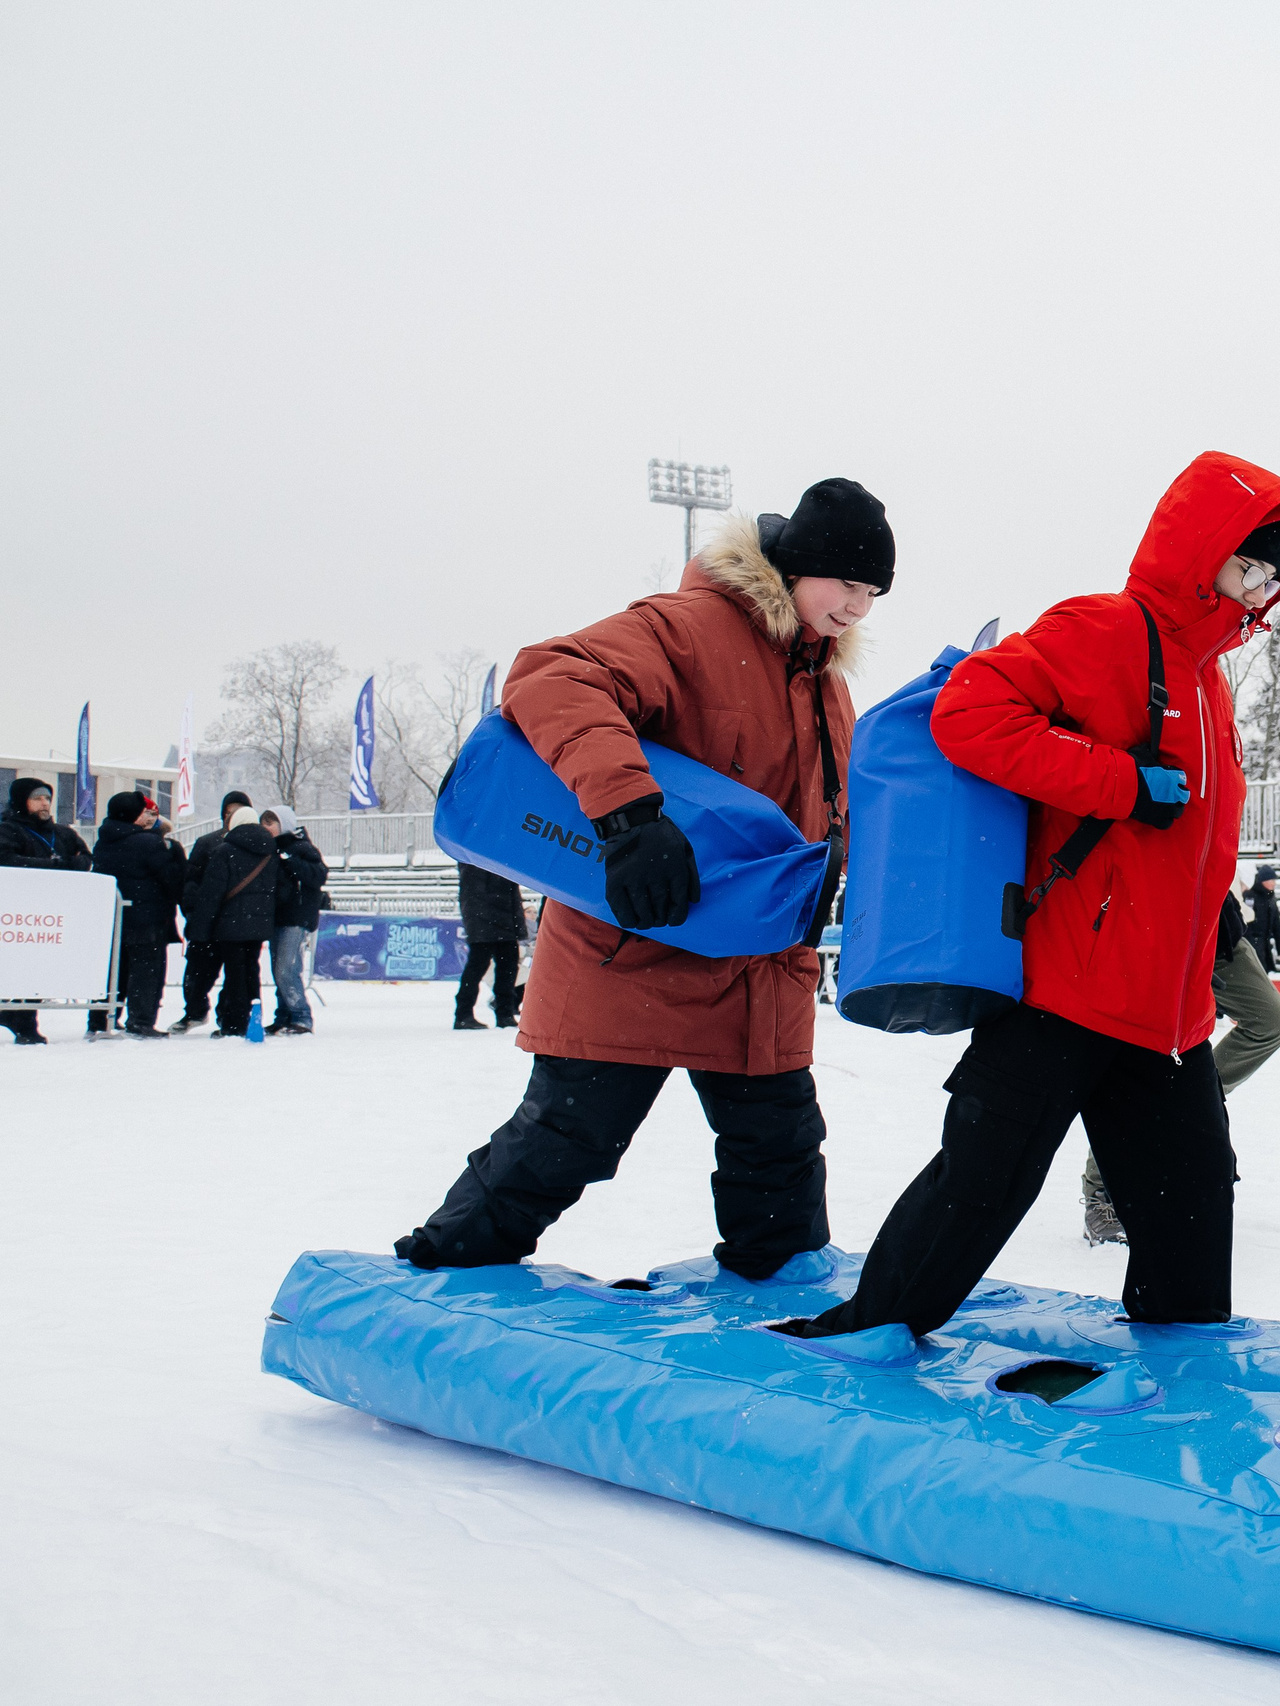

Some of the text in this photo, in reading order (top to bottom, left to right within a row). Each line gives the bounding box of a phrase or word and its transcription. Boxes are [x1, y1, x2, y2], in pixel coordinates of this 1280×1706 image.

[1163, 709, 1181, 718] ARD
[1, 913, 64, 928] ОВСКОЕ
[0, 930, 63, 944] ОВАНИЕ
[388, 924, 438, 944] ЗИМНИЙ
